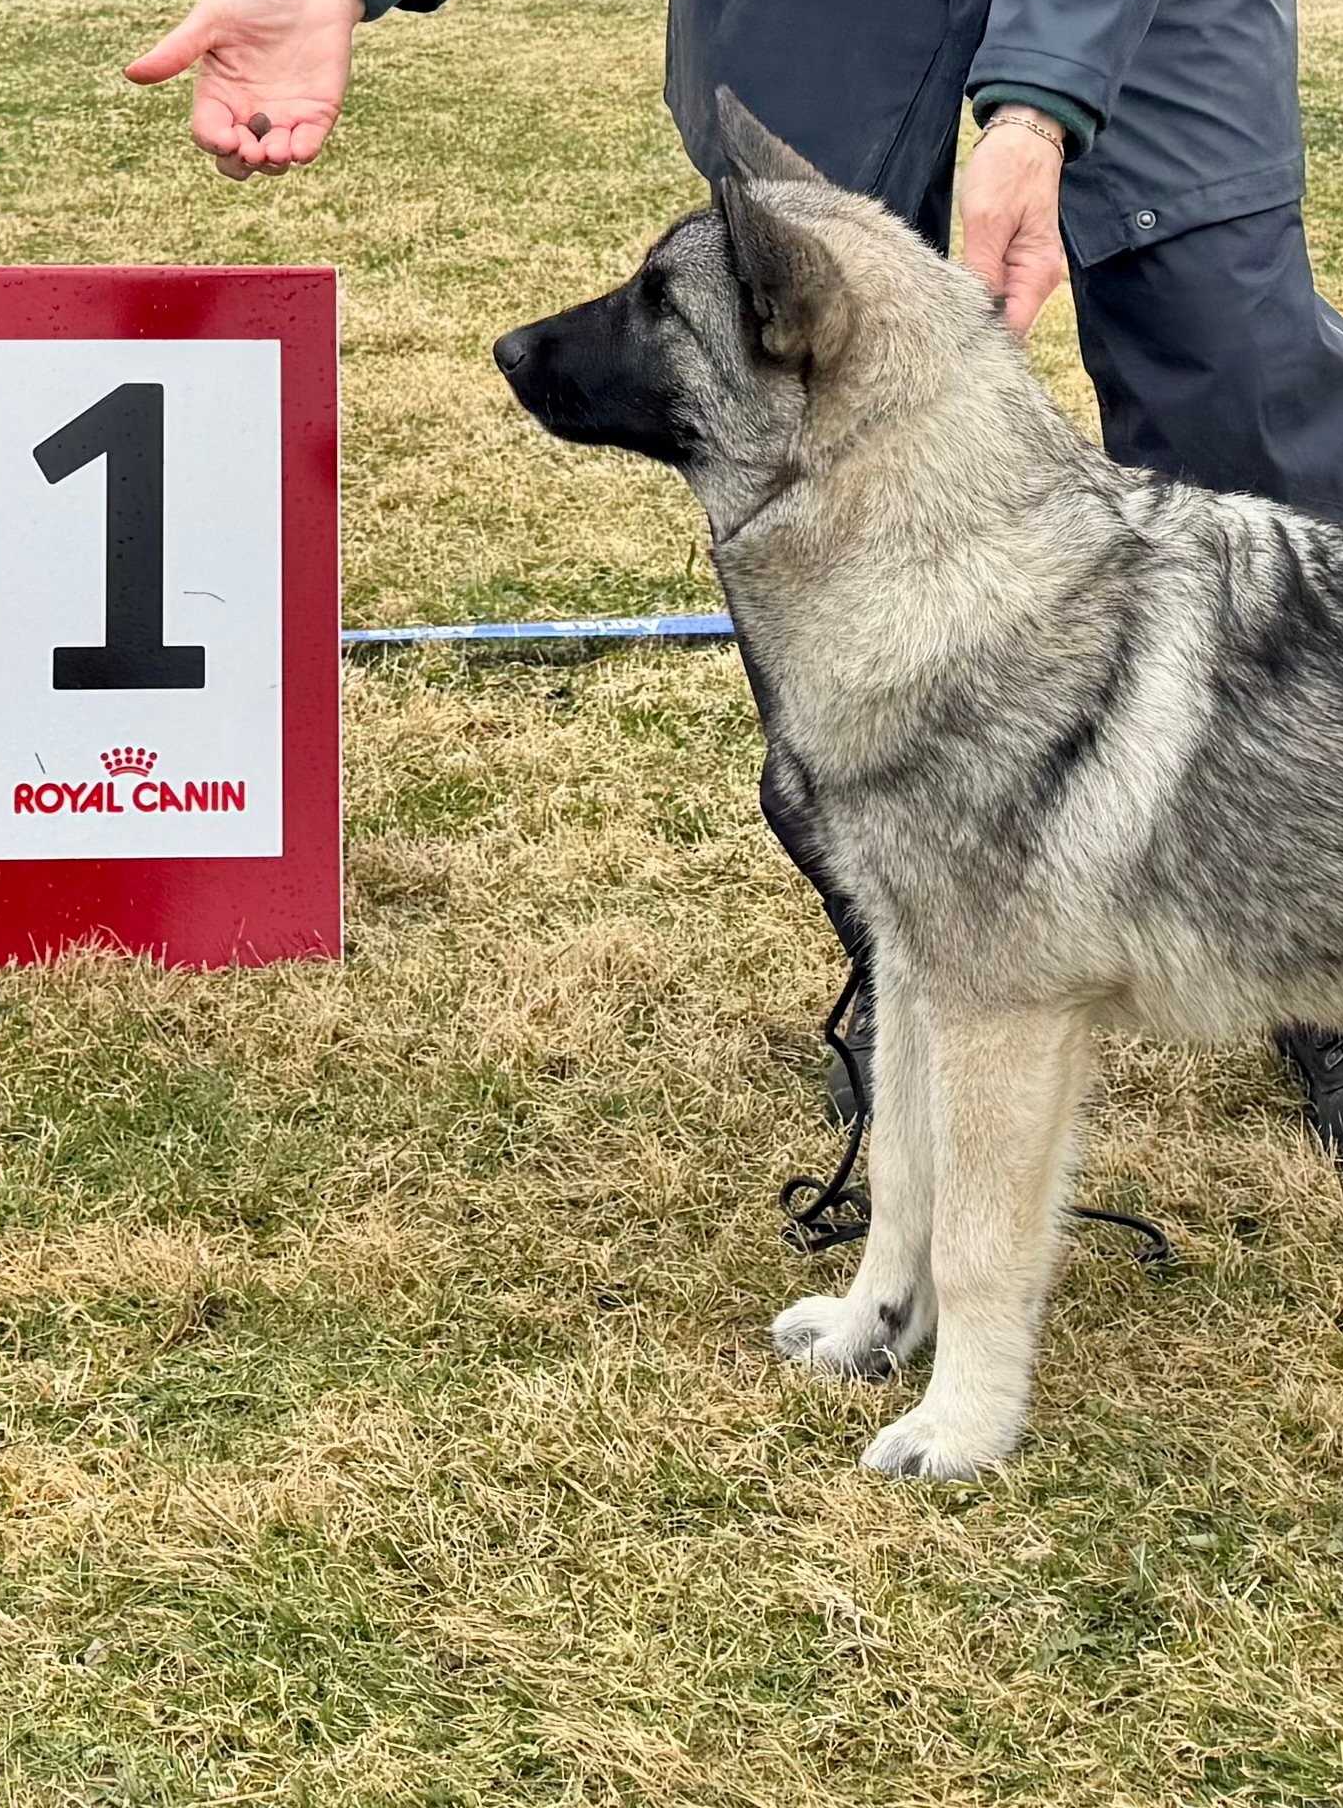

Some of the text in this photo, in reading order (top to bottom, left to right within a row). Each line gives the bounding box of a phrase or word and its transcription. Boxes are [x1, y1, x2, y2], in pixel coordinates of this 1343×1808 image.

[32, 382, 205, 690] 1
[13, 780, 246, 814] ROYAL CANIN
